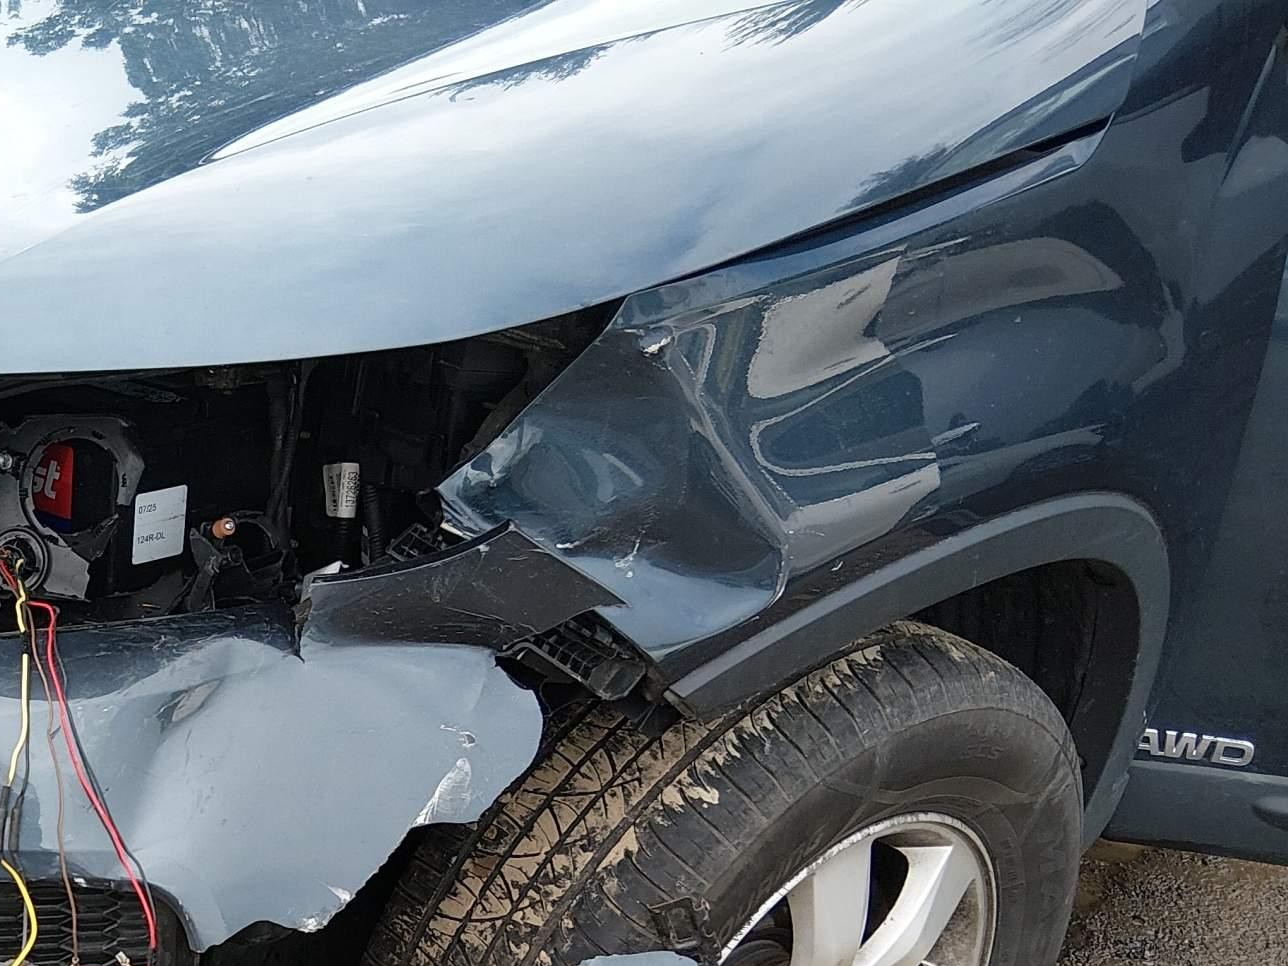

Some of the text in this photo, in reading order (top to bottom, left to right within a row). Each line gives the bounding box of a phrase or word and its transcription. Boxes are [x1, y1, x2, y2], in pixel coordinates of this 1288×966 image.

[138, 503, 158, 515] 07/25
[137, 531, 167, 545] 124R-DL
[1137, 728, 1255, 767] AWD
